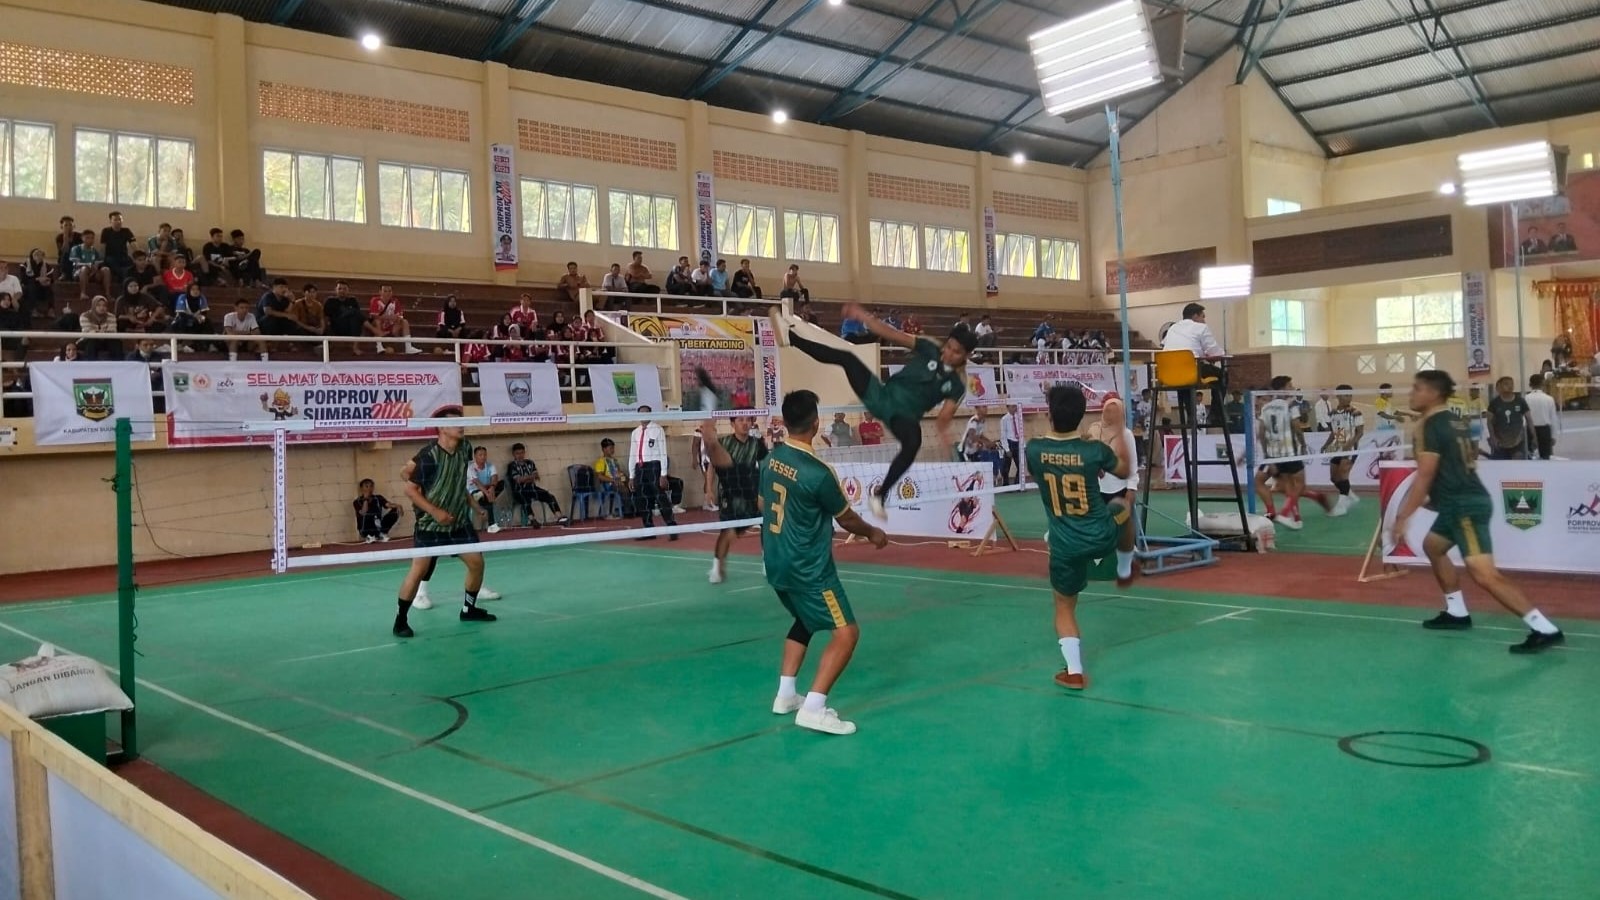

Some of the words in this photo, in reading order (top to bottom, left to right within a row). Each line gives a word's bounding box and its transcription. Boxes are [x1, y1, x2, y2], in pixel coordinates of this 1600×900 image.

[688, 340, 744, 349] BERTANDING
[247, 373, 318, 386] SELAMAT
[322, 374, 374, 386] DATANG
[378, 374, 442, 386] PESERTA
[304, 390, 379, 405] PORPROV
[383, 390, 408, 404] XVI
[304, 407, 372, 420] SUMBAR
[371, 399, 414, 419] 2026
[1041, 453, 1084, 466] PESSEL
[768, 458, 798, 481] PESSEL
[1043, 472, 1089, 516] 19
[770, 482, 787, 534] 3
[10, 676, 50, 694] JANGAN
